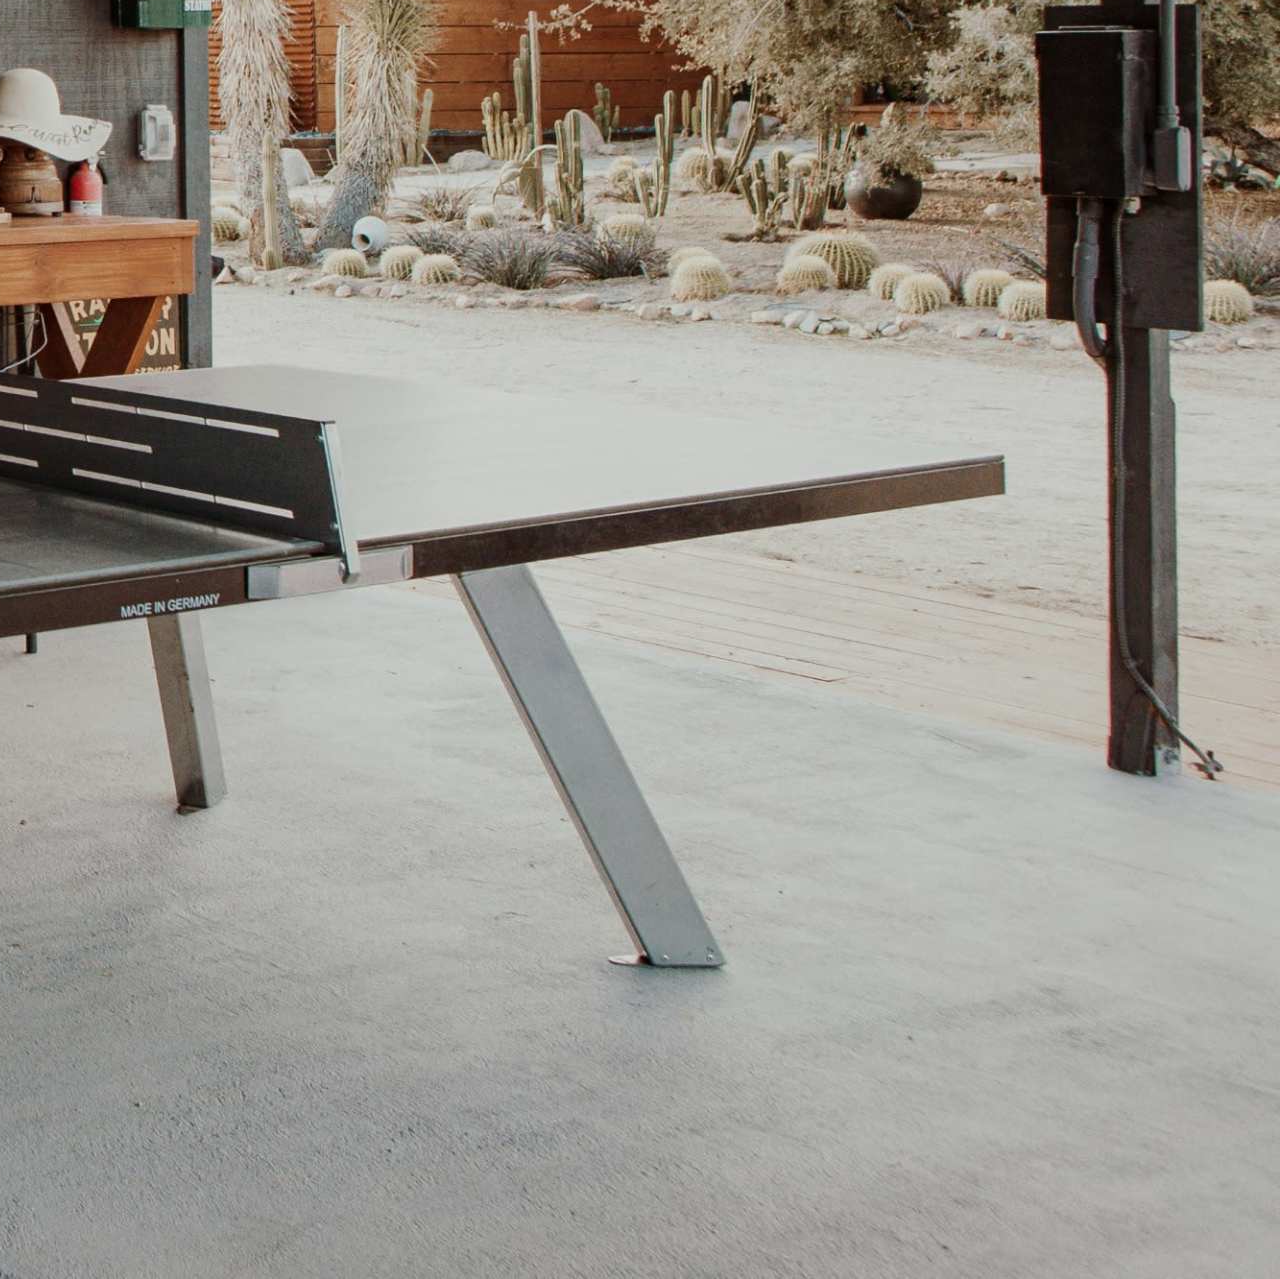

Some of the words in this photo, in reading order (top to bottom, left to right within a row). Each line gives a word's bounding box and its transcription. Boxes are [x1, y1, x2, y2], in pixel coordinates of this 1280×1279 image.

[120, 602, 152, 619] MADE
[154, 601, 166, 614] IN
[167, 593, 221, 612] GERMANY
